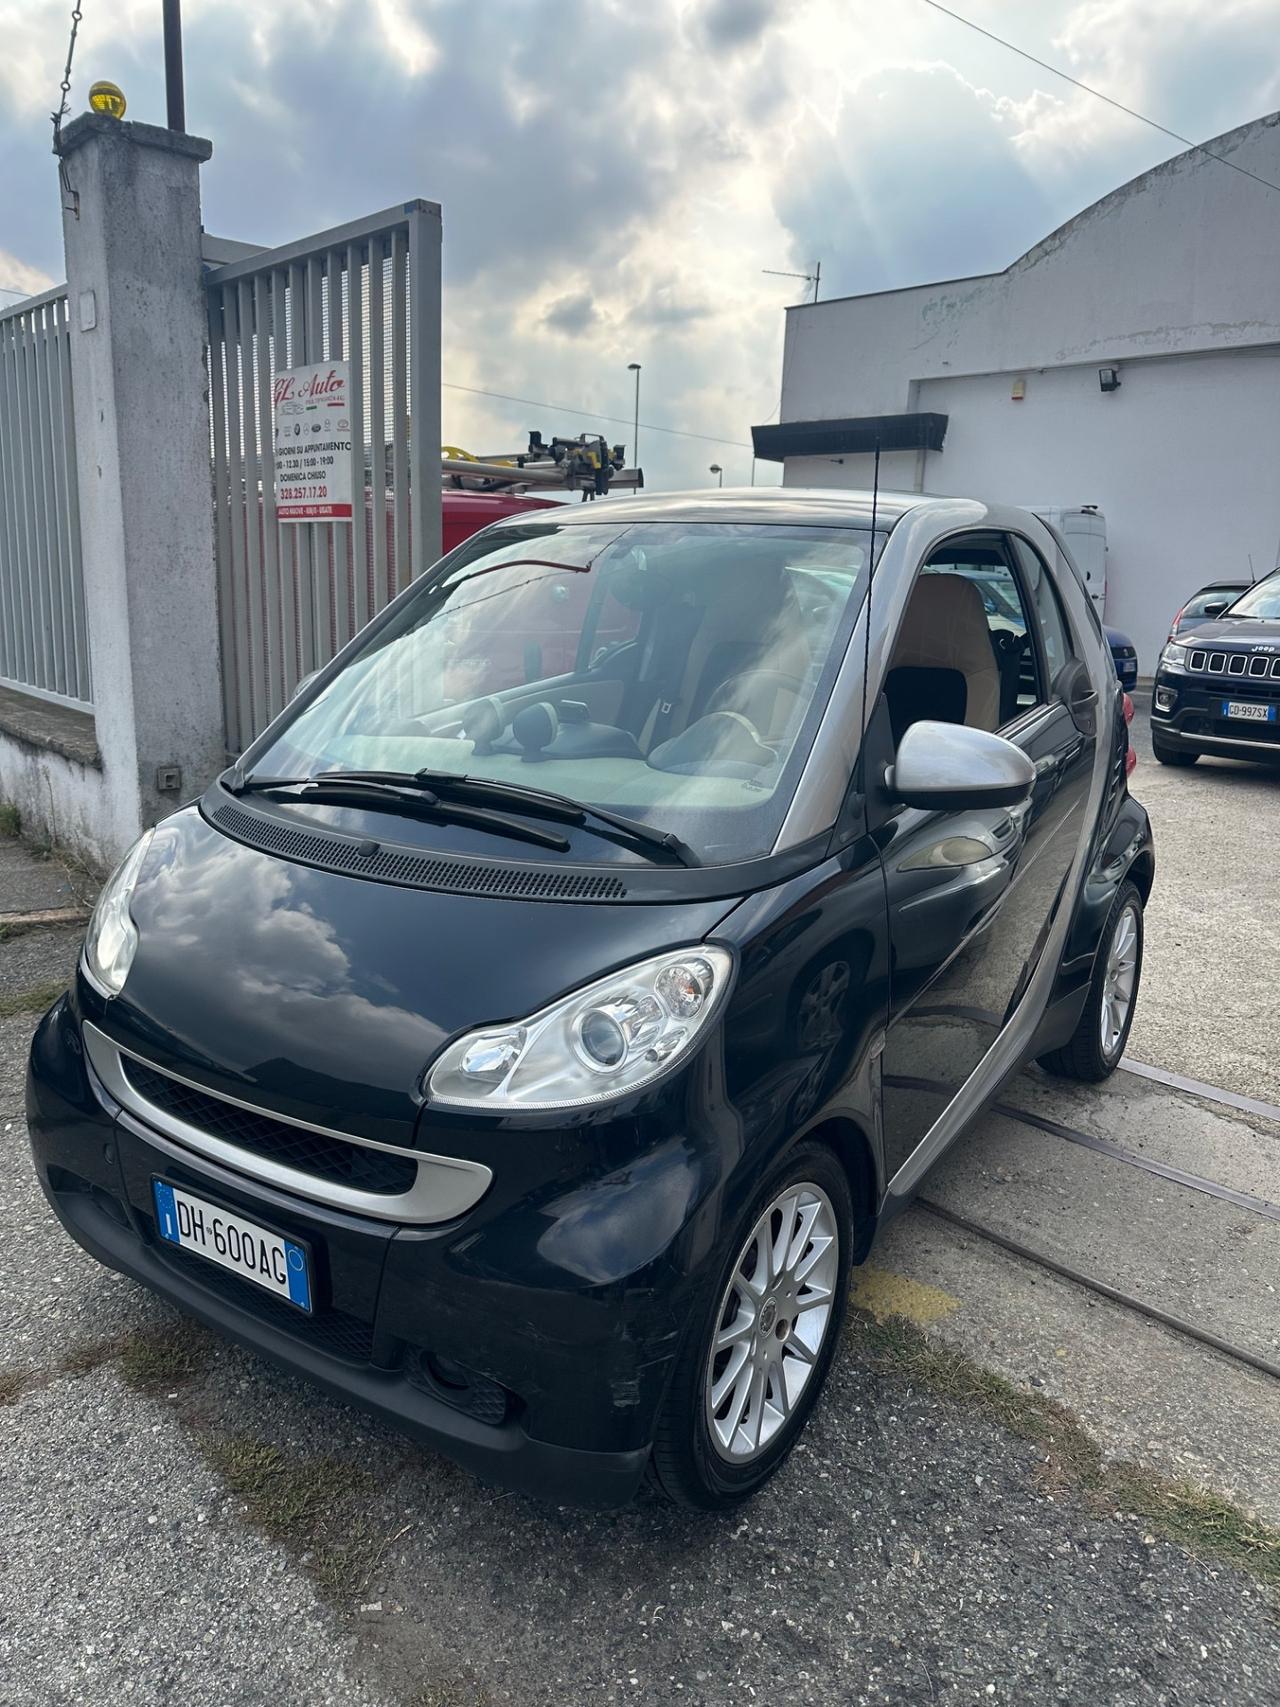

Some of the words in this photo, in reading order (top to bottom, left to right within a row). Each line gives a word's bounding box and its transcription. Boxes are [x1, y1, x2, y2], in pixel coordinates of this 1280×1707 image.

[298, 370, 345, 397] Auto
[297, 445, 303, 454] SU
[304, 442, 351, 454] APPUNTAMENTO
[280, 473, 307, 482] DOMENICA
[307, 470, 326, 480] CHIUSO
